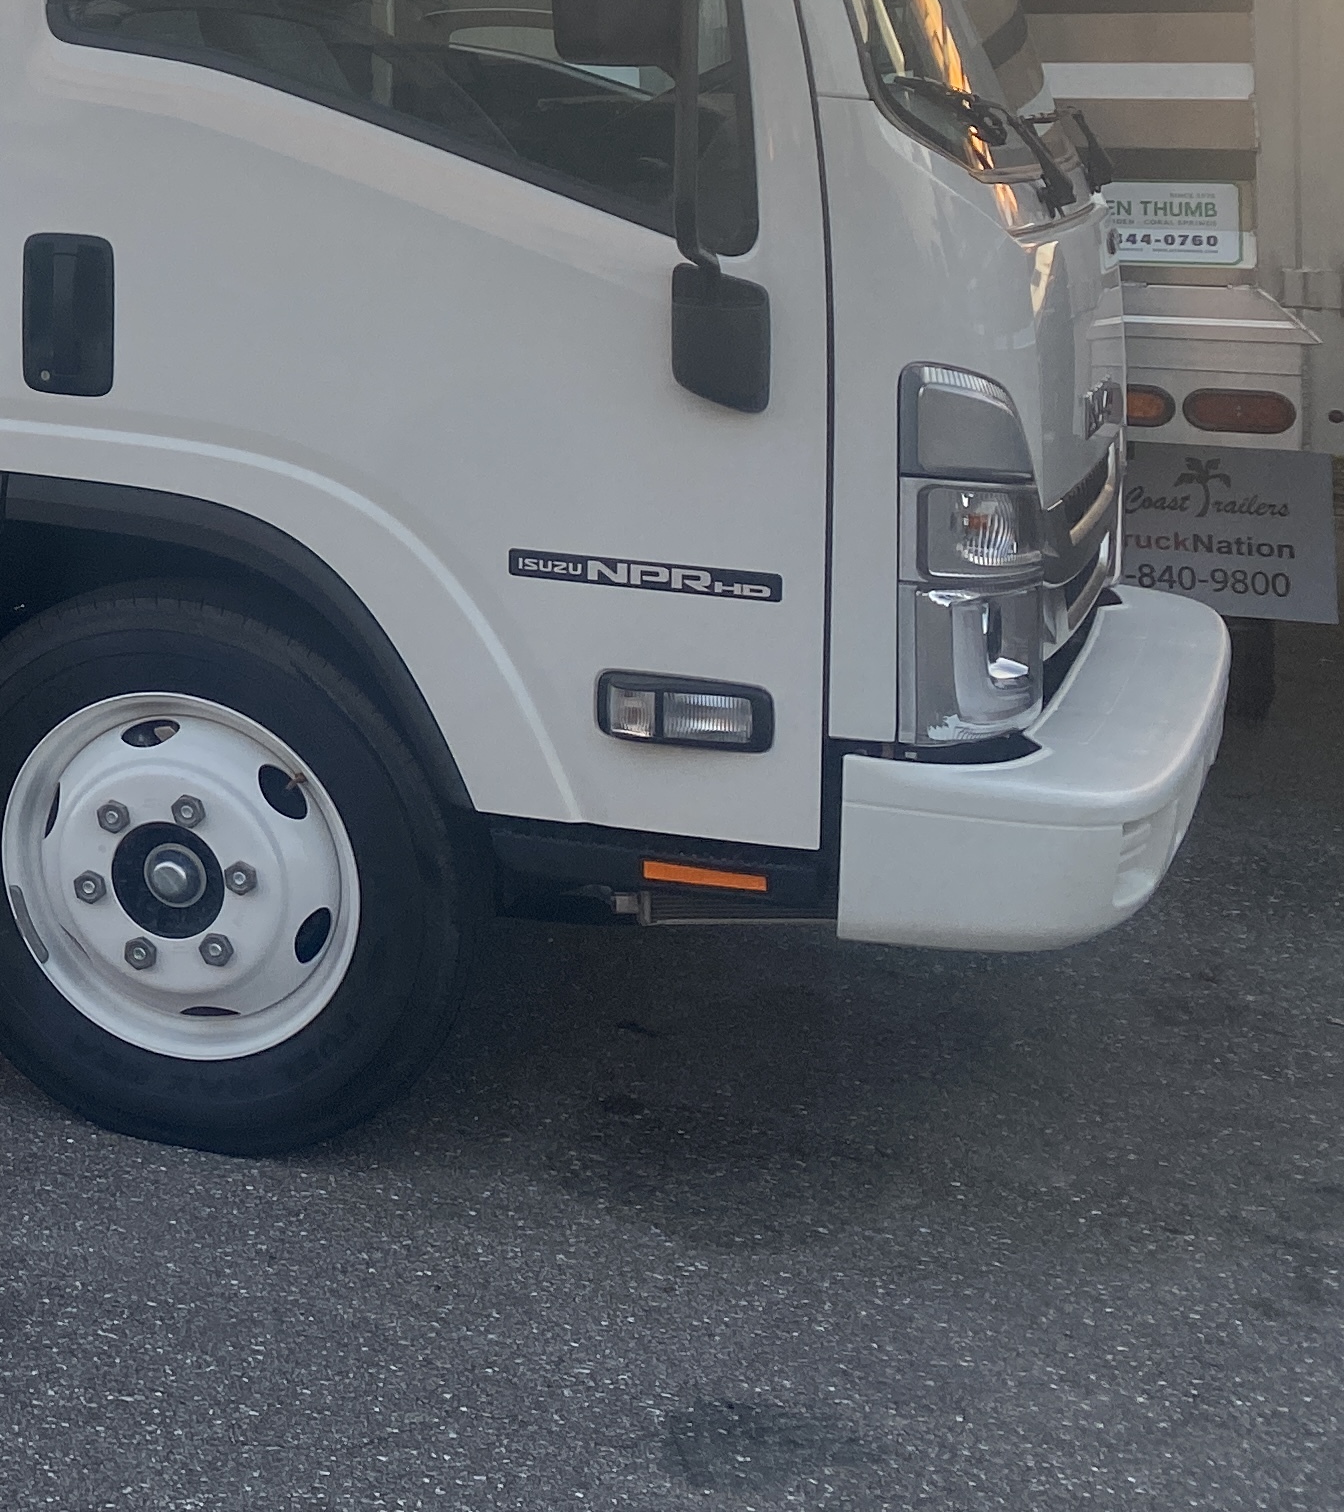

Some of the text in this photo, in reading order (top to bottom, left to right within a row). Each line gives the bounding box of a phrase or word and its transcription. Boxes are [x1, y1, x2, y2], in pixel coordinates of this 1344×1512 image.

[1106, 200, 1218, 218] EN THUMB
[1125, 486, 1191, 514] Coast
[1125, 531, 1296, 559] ruckNation
[518, 557, 582, 576] ISUZU
[587, 560, 712, 593] NPR
[1125, 563, 1291, 598] -840-9800
